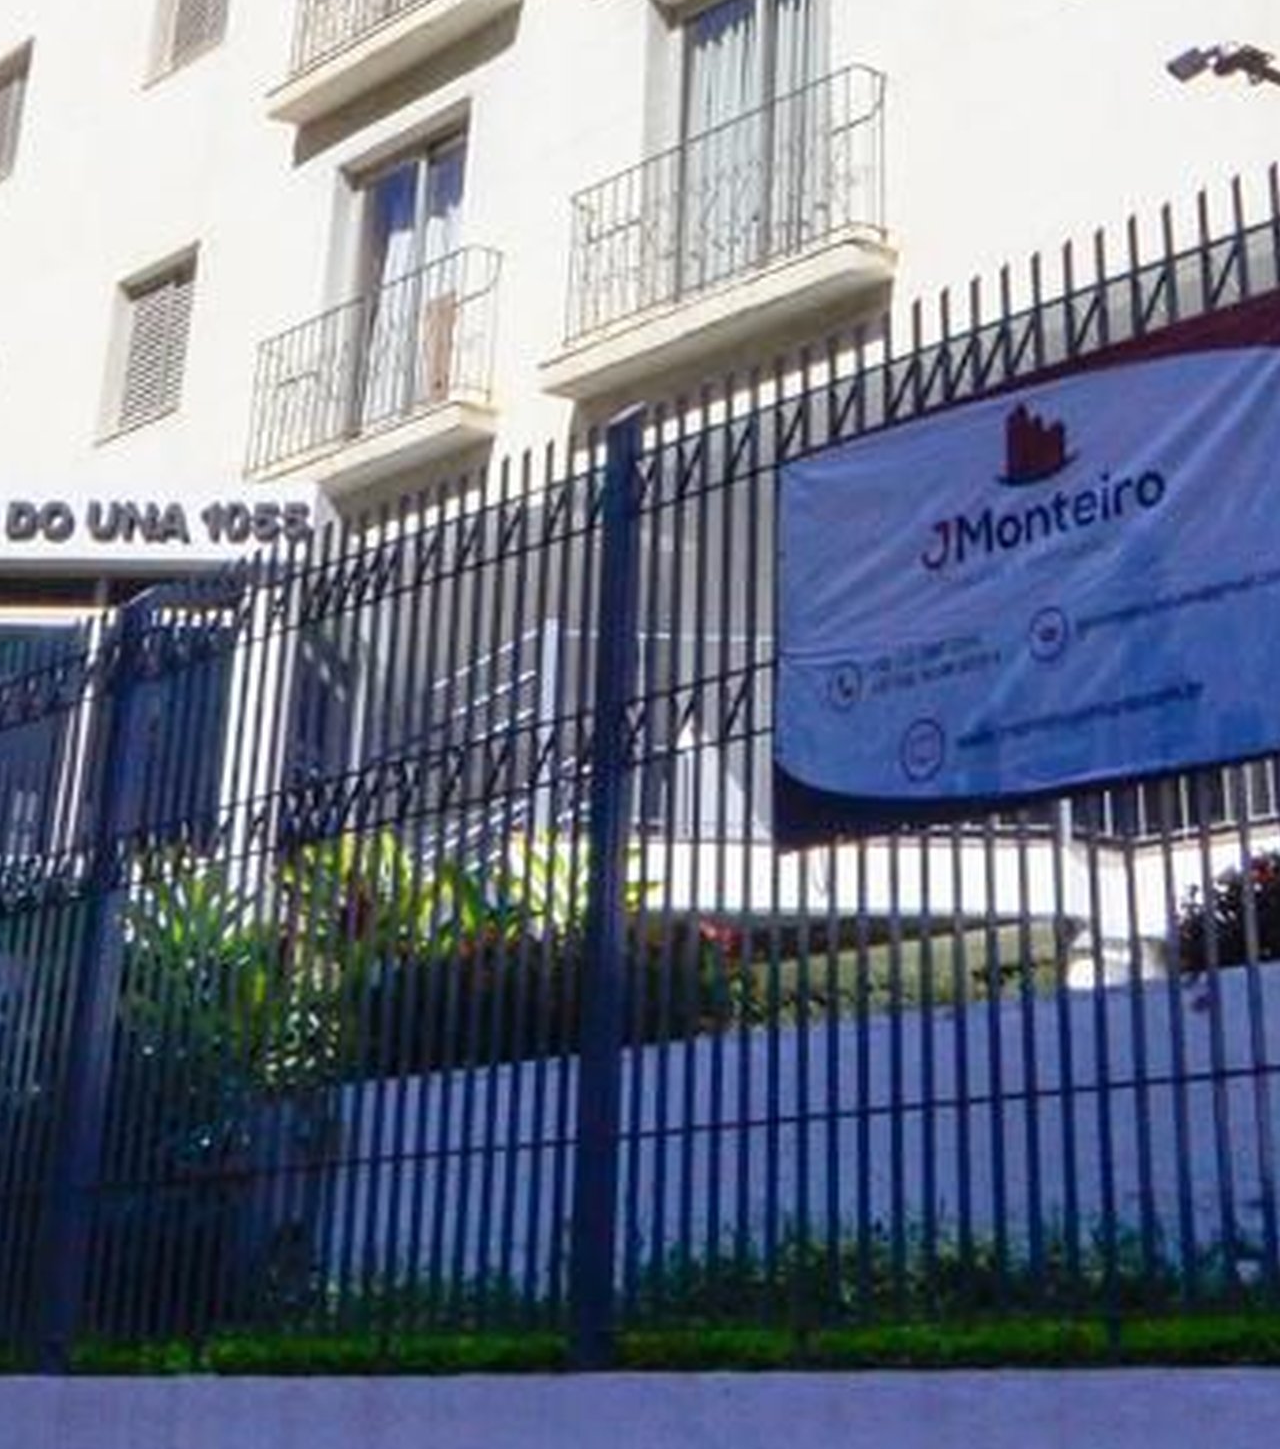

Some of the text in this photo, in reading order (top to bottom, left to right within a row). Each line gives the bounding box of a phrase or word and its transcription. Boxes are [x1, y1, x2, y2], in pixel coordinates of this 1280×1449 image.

[6, 500, 75, 542] DO
[87, 499, 190, 543] UNA
[201, 501, 312, 544] 1055
[922, 468, 1166, 570] JMonteiro
